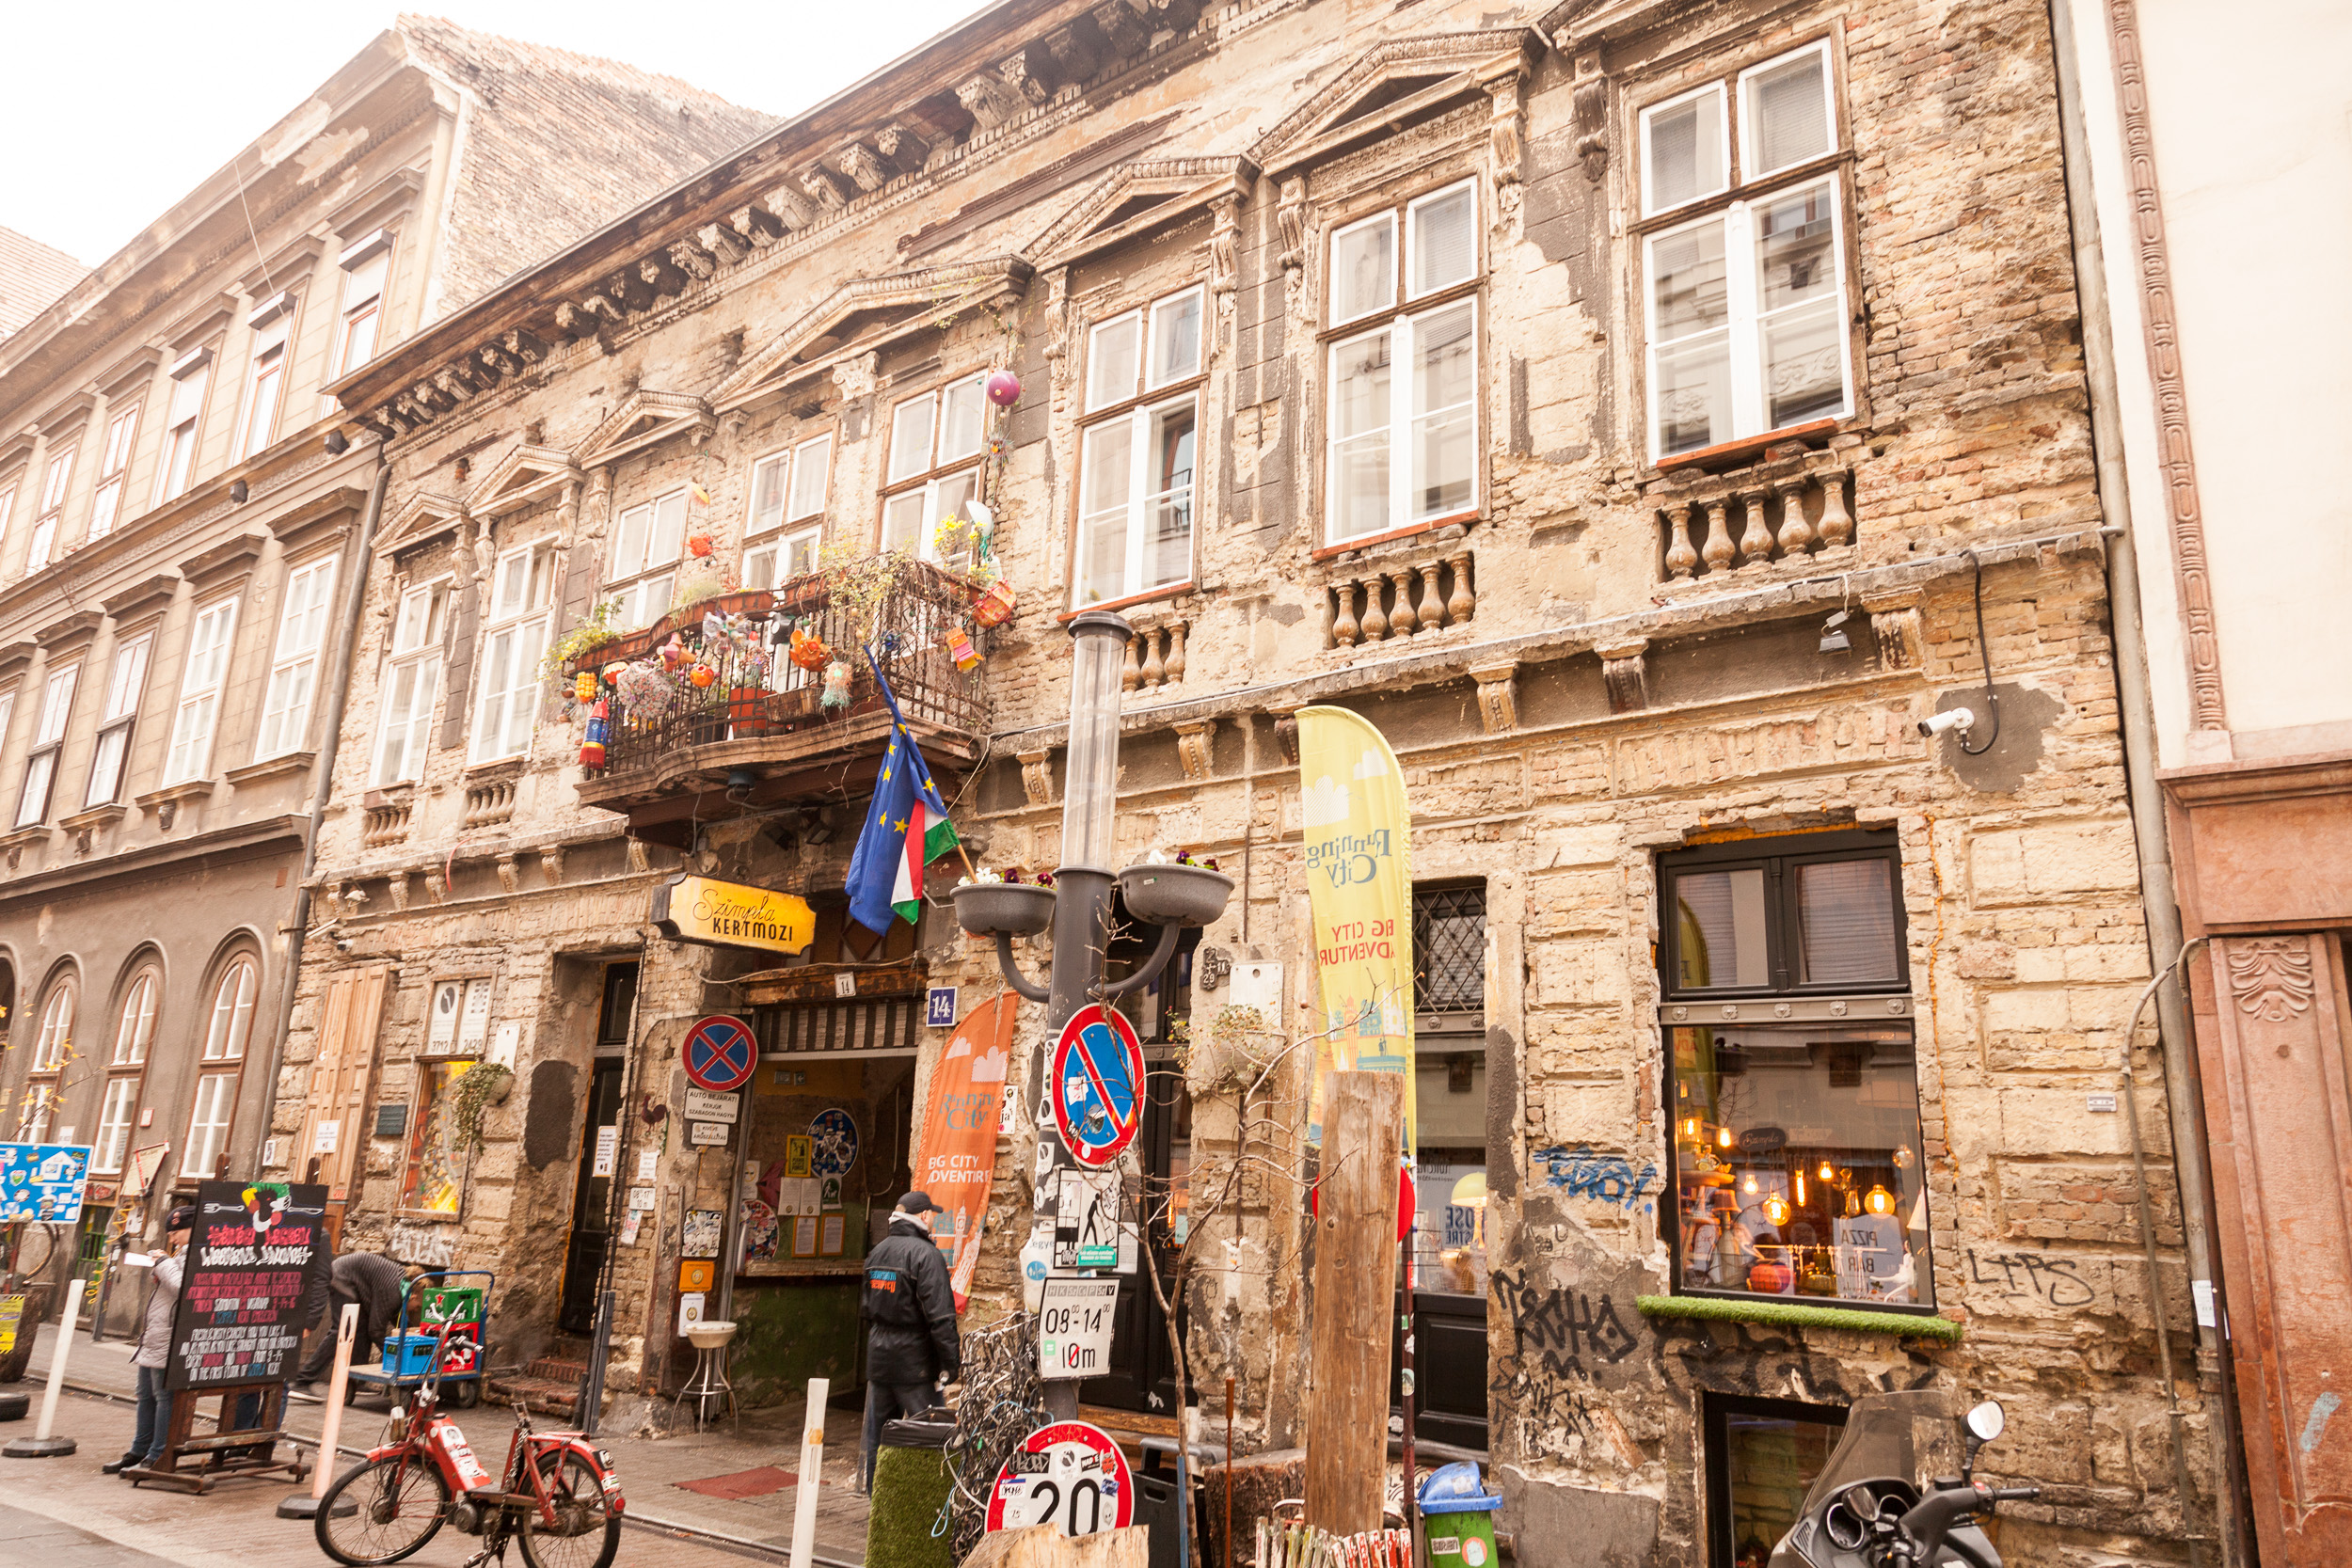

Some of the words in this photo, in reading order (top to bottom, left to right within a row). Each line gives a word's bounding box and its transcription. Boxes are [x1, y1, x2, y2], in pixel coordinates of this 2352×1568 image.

[692, 888, 776, 931] Szimpla
[712, 916, 793, 942] KERTMOZI
[841, 979, 850, 994] 14
[931, 994, 952, 1019] 14
[946, 1108, 988, 1131] City
[928, 1155, 946, 1170] BG
[949, 1154, 979, 1169] CITY
[1107, 1286, 1114, 1295] V
[1030, 1478, 1101, 1537] 20
